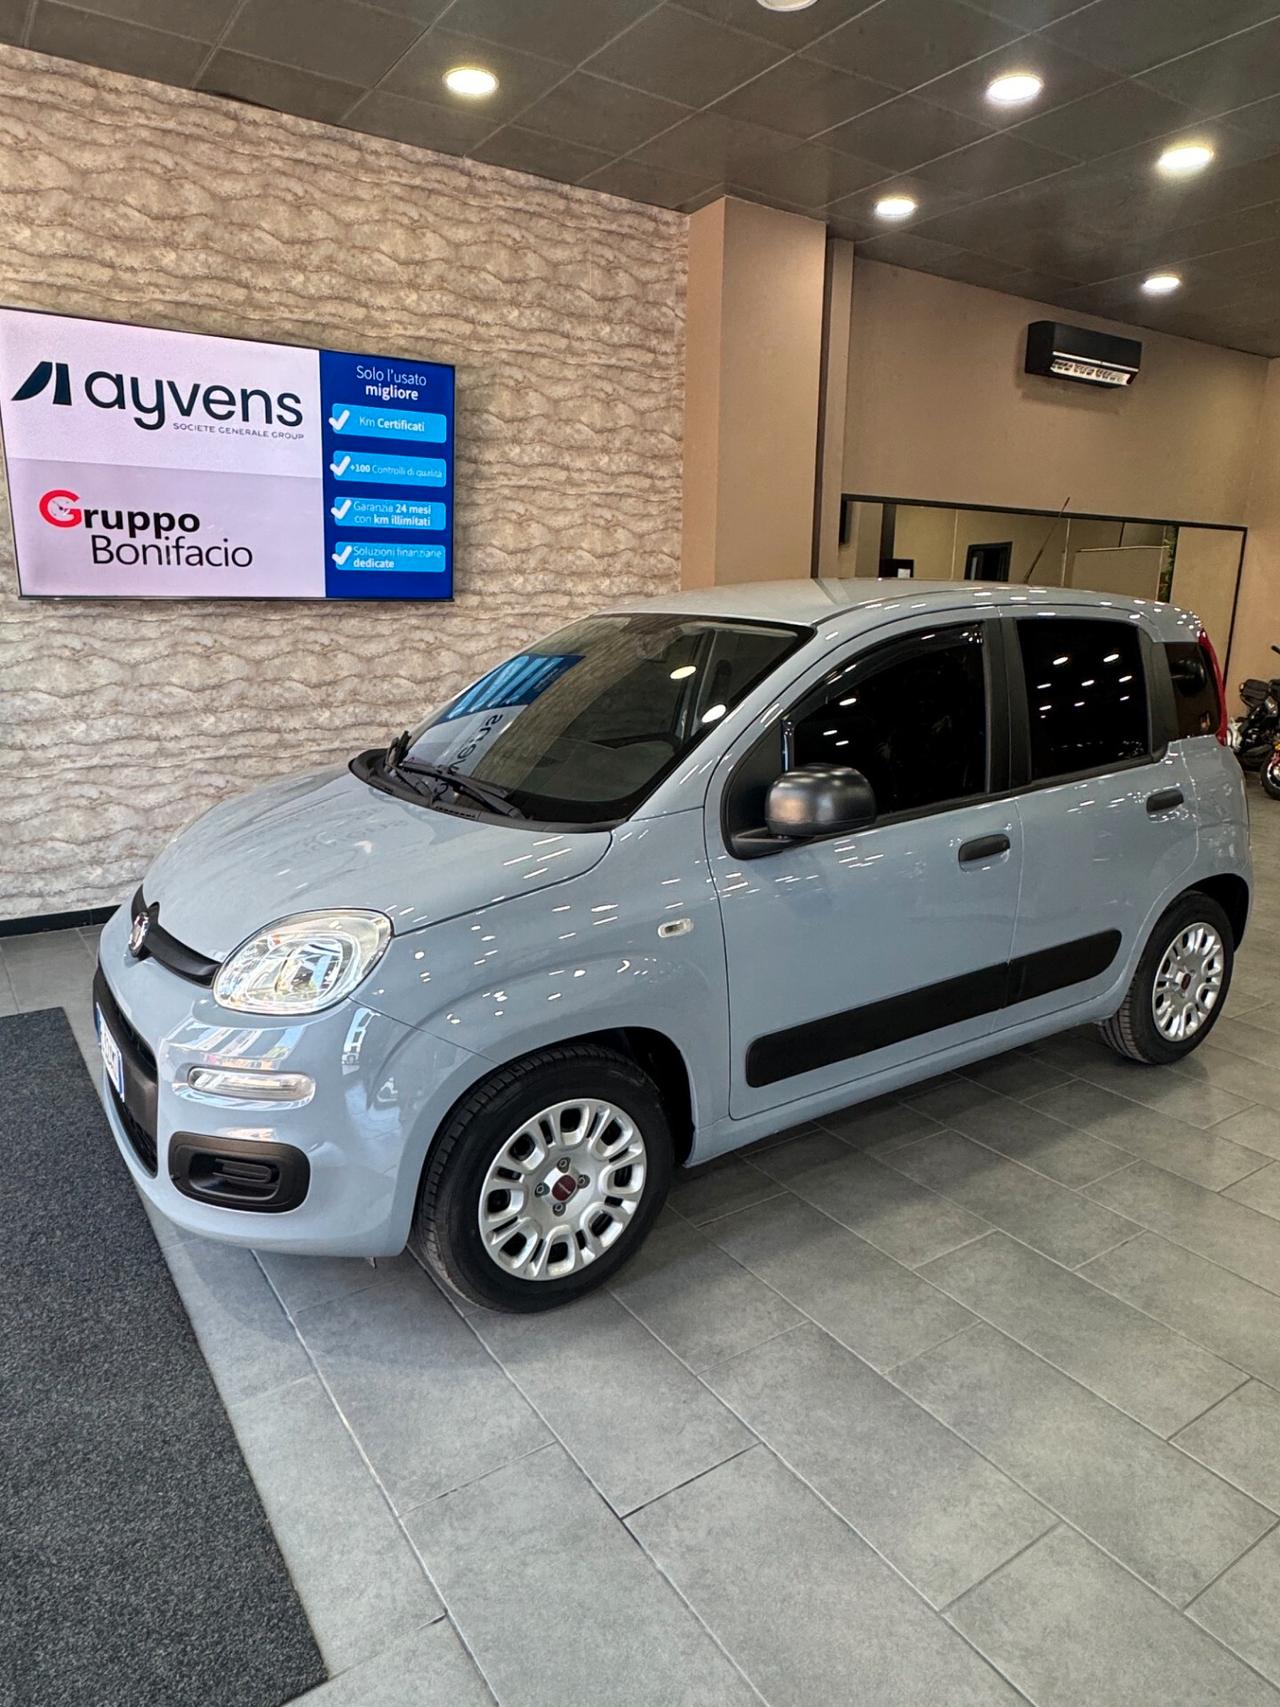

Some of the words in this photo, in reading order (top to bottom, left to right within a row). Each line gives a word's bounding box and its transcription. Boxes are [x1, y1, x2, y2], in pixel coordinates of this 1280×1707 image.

[356, 365, 384, 381] Solo
[365, 383, 419, 401] migliore
[85, 370, 303, 430] ayvens
[359, 416, 375, 427] Km
[377, 418, 425, 432] Certificati
[218, 426, 269, 438] GENERALE
[272, 430, 304, 440] GROUP
[350, 464, 370, 473] +100
[39, 490, 200, 538] Gruppo
[353, 501, 393, 512] Garanzia
[396, 504, 407, 514] 24
[409, 504, 431, 515] mesi
[354, 515, 372, 524] con
[374, 515, 389, 525] km
[391, 515, 431, 526] illimitati
[91, 535, 253, 567] Bonifacio
[353, 546, 395, 557] Soluzioni
[353, 558, 394, 569] dedicate
